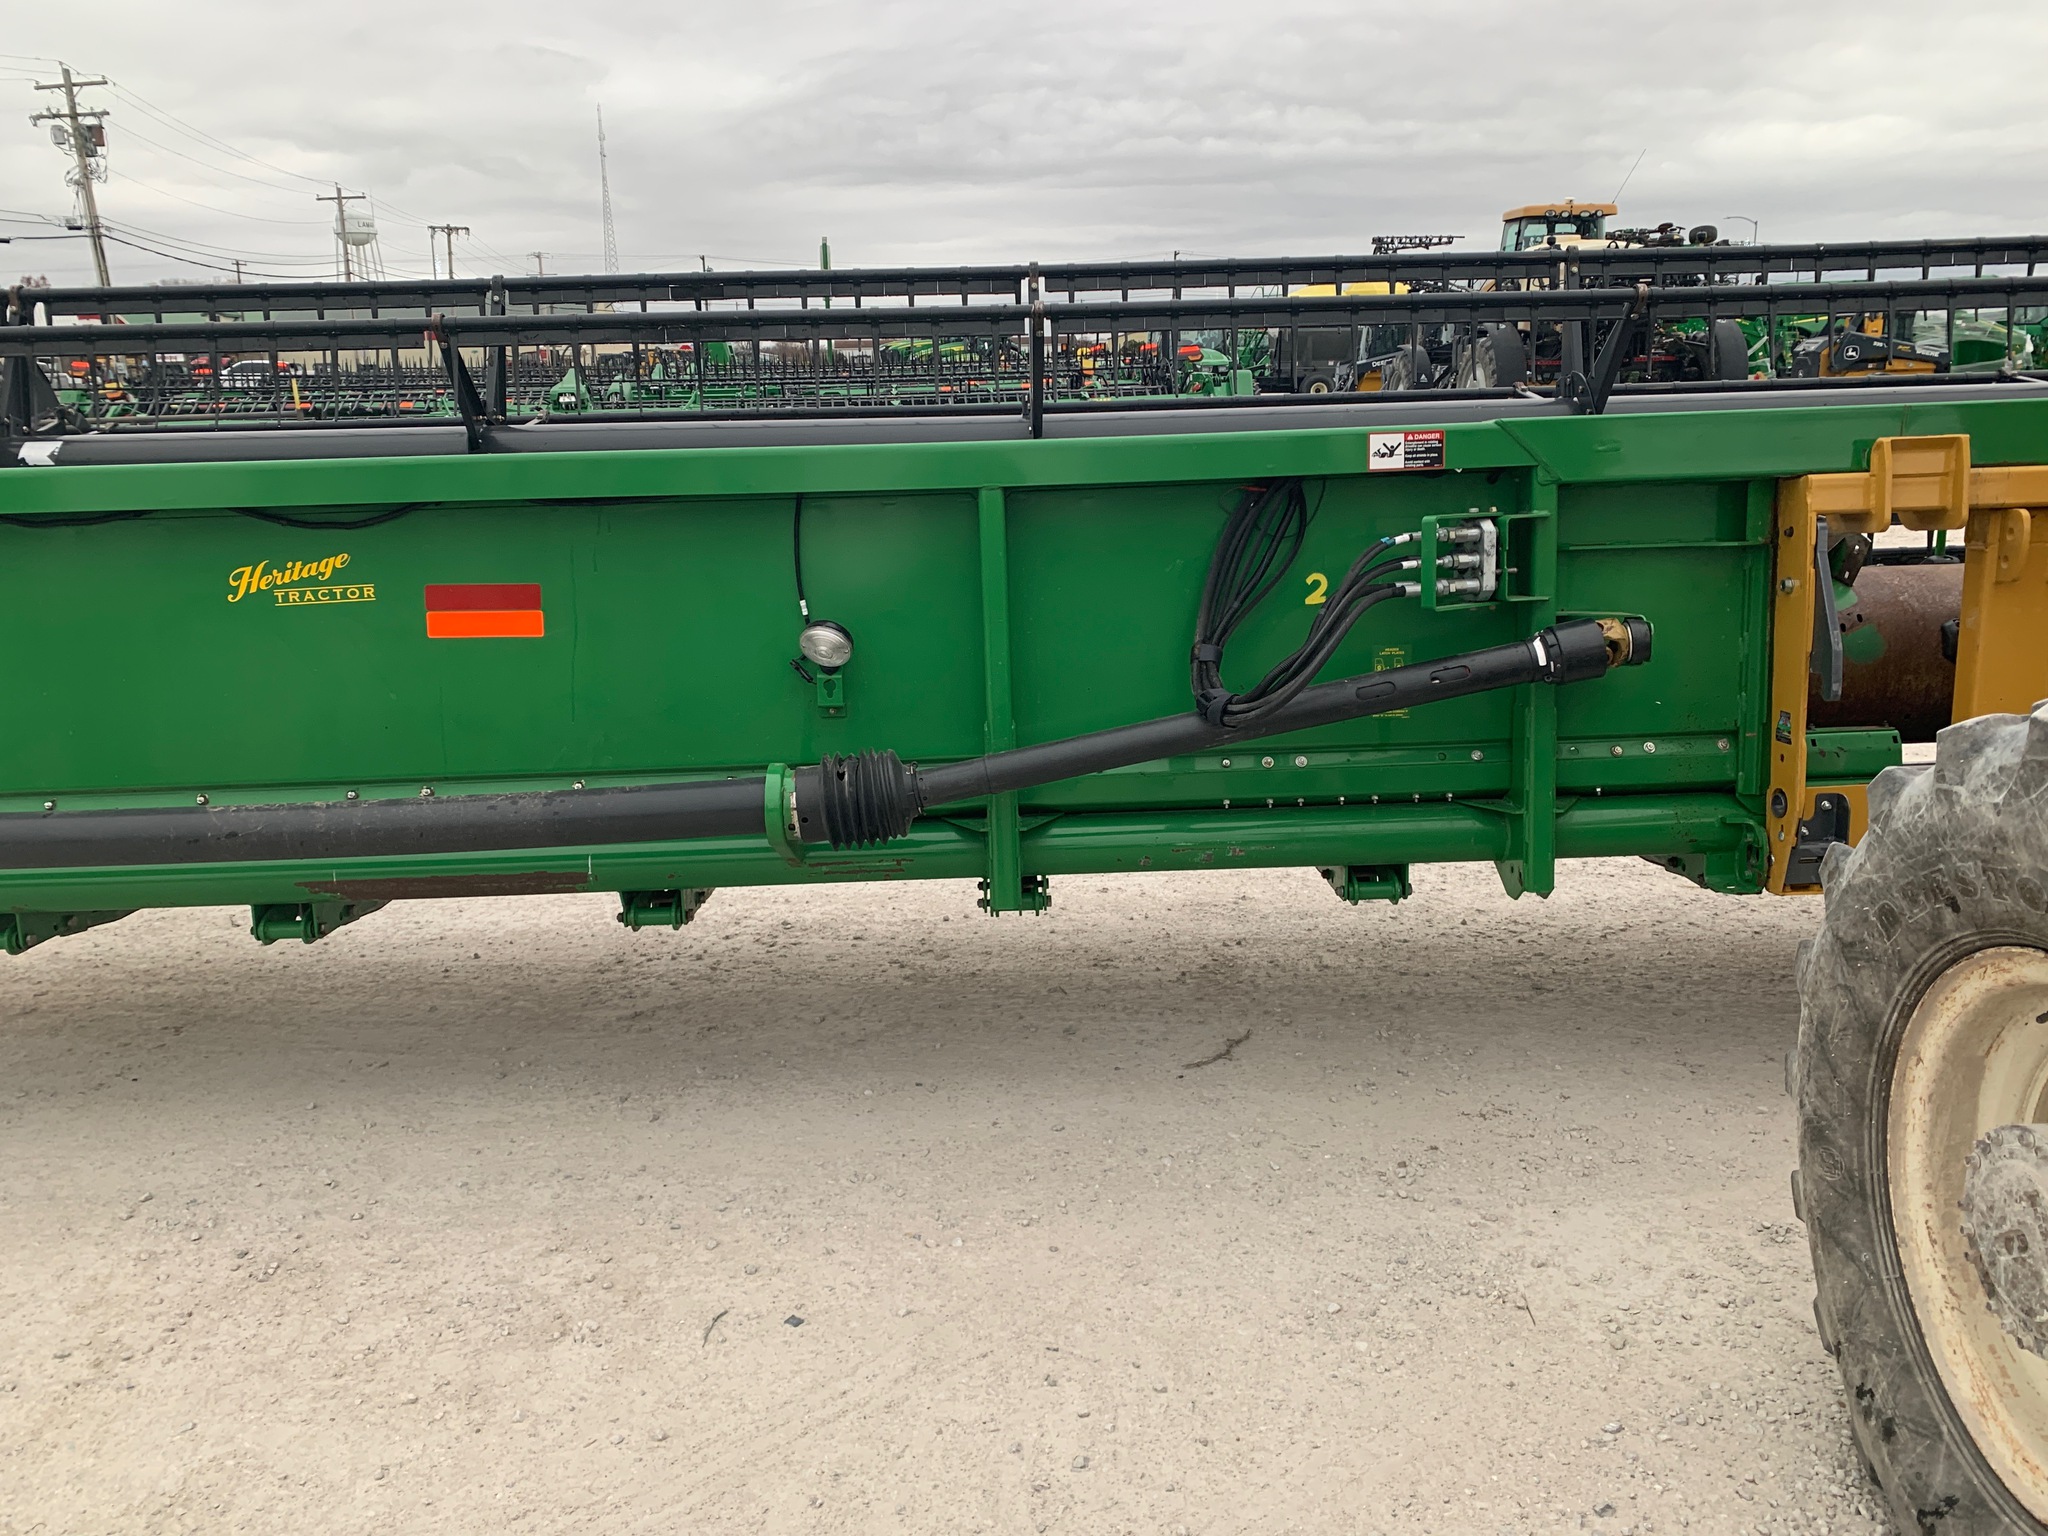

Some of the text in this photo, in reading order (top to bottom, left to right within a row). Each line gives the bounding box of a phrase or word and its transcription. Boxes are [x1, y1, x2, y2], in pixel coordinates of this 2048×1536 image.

[227, 552, 352, 603] Heritage
[1304, 572, 1329, 605] 2
[274, 586, 376, 604] TRACTOR
